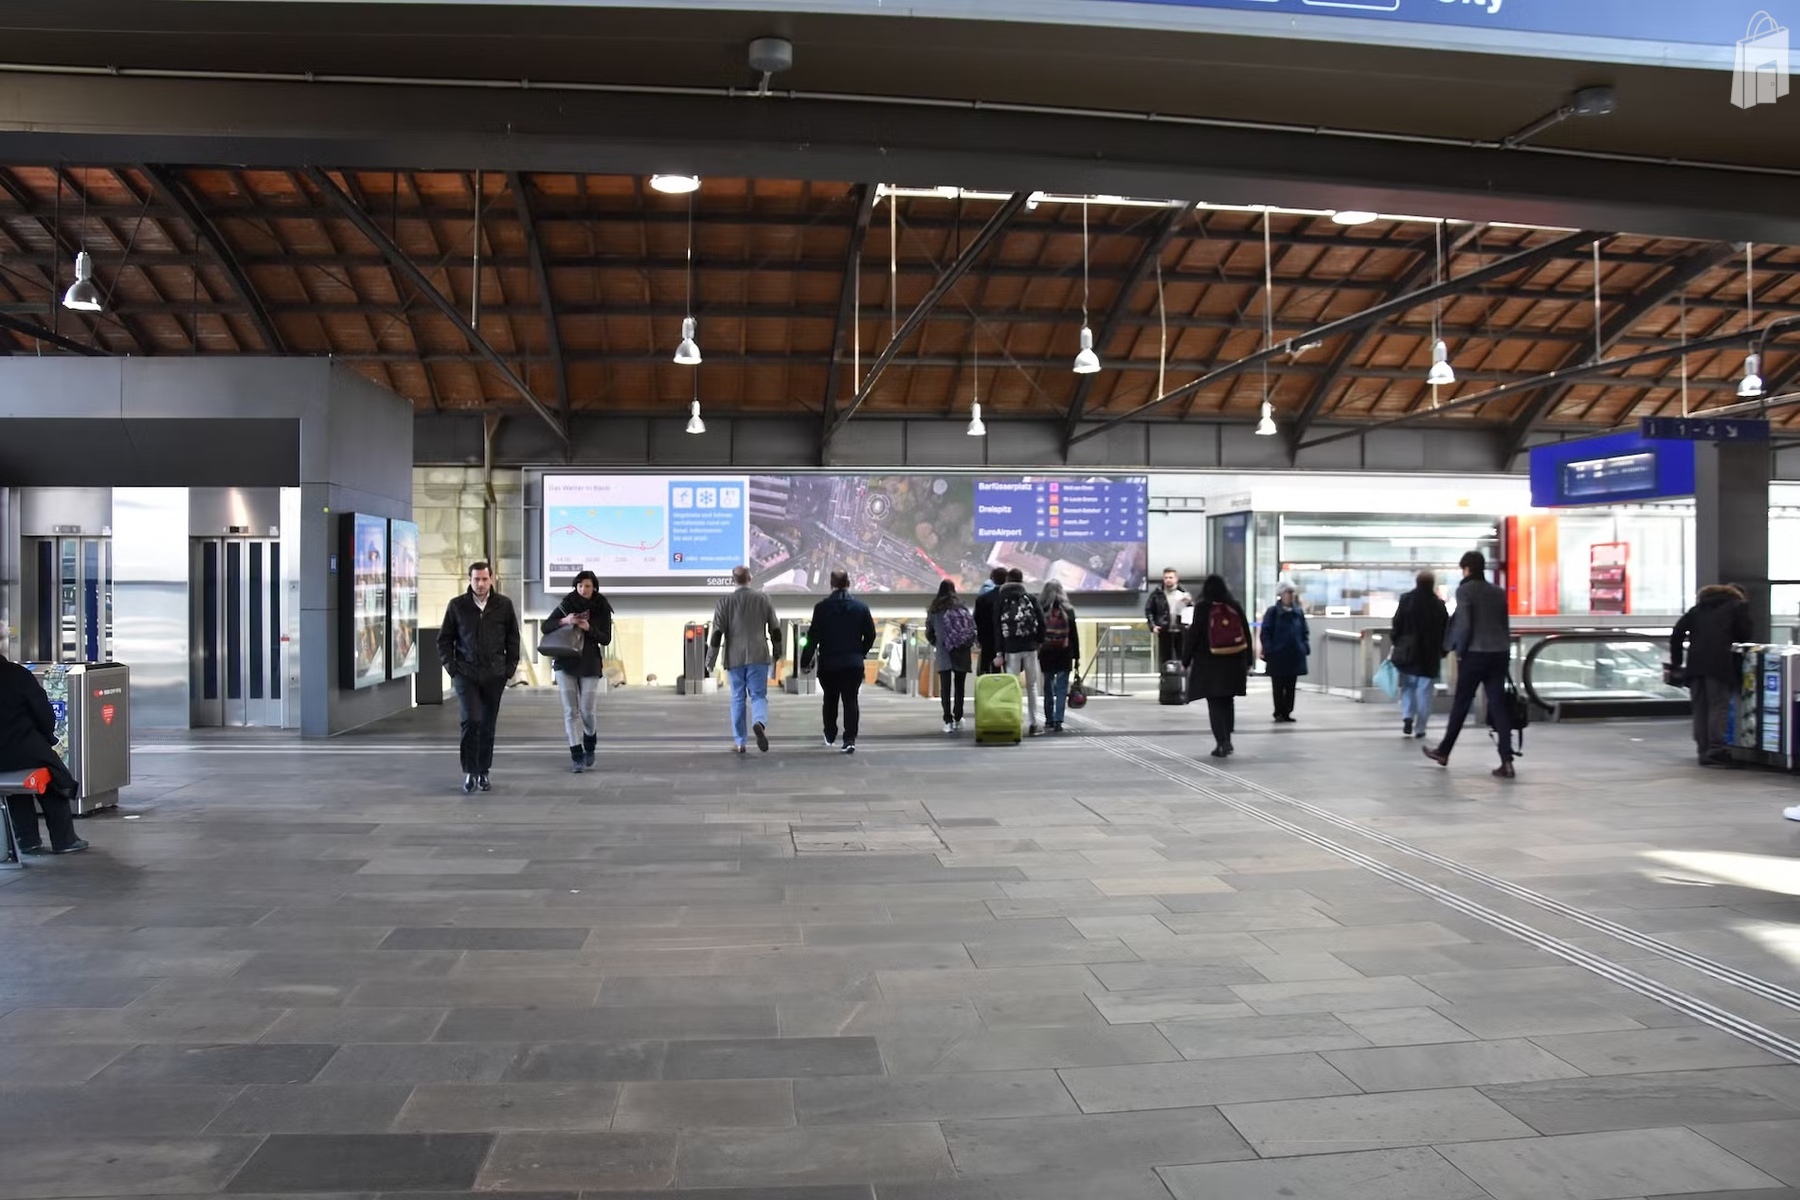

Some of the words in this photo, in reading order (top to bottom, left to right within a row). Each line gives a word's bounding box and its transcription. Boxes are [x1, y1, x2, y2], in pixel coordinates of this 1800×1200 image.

[978, 482, 1033, 492] Barfüsserplatz
[978, 505, 1012, 515] Dreispitz
[978, 528, 1023, 537] EuroAirport
